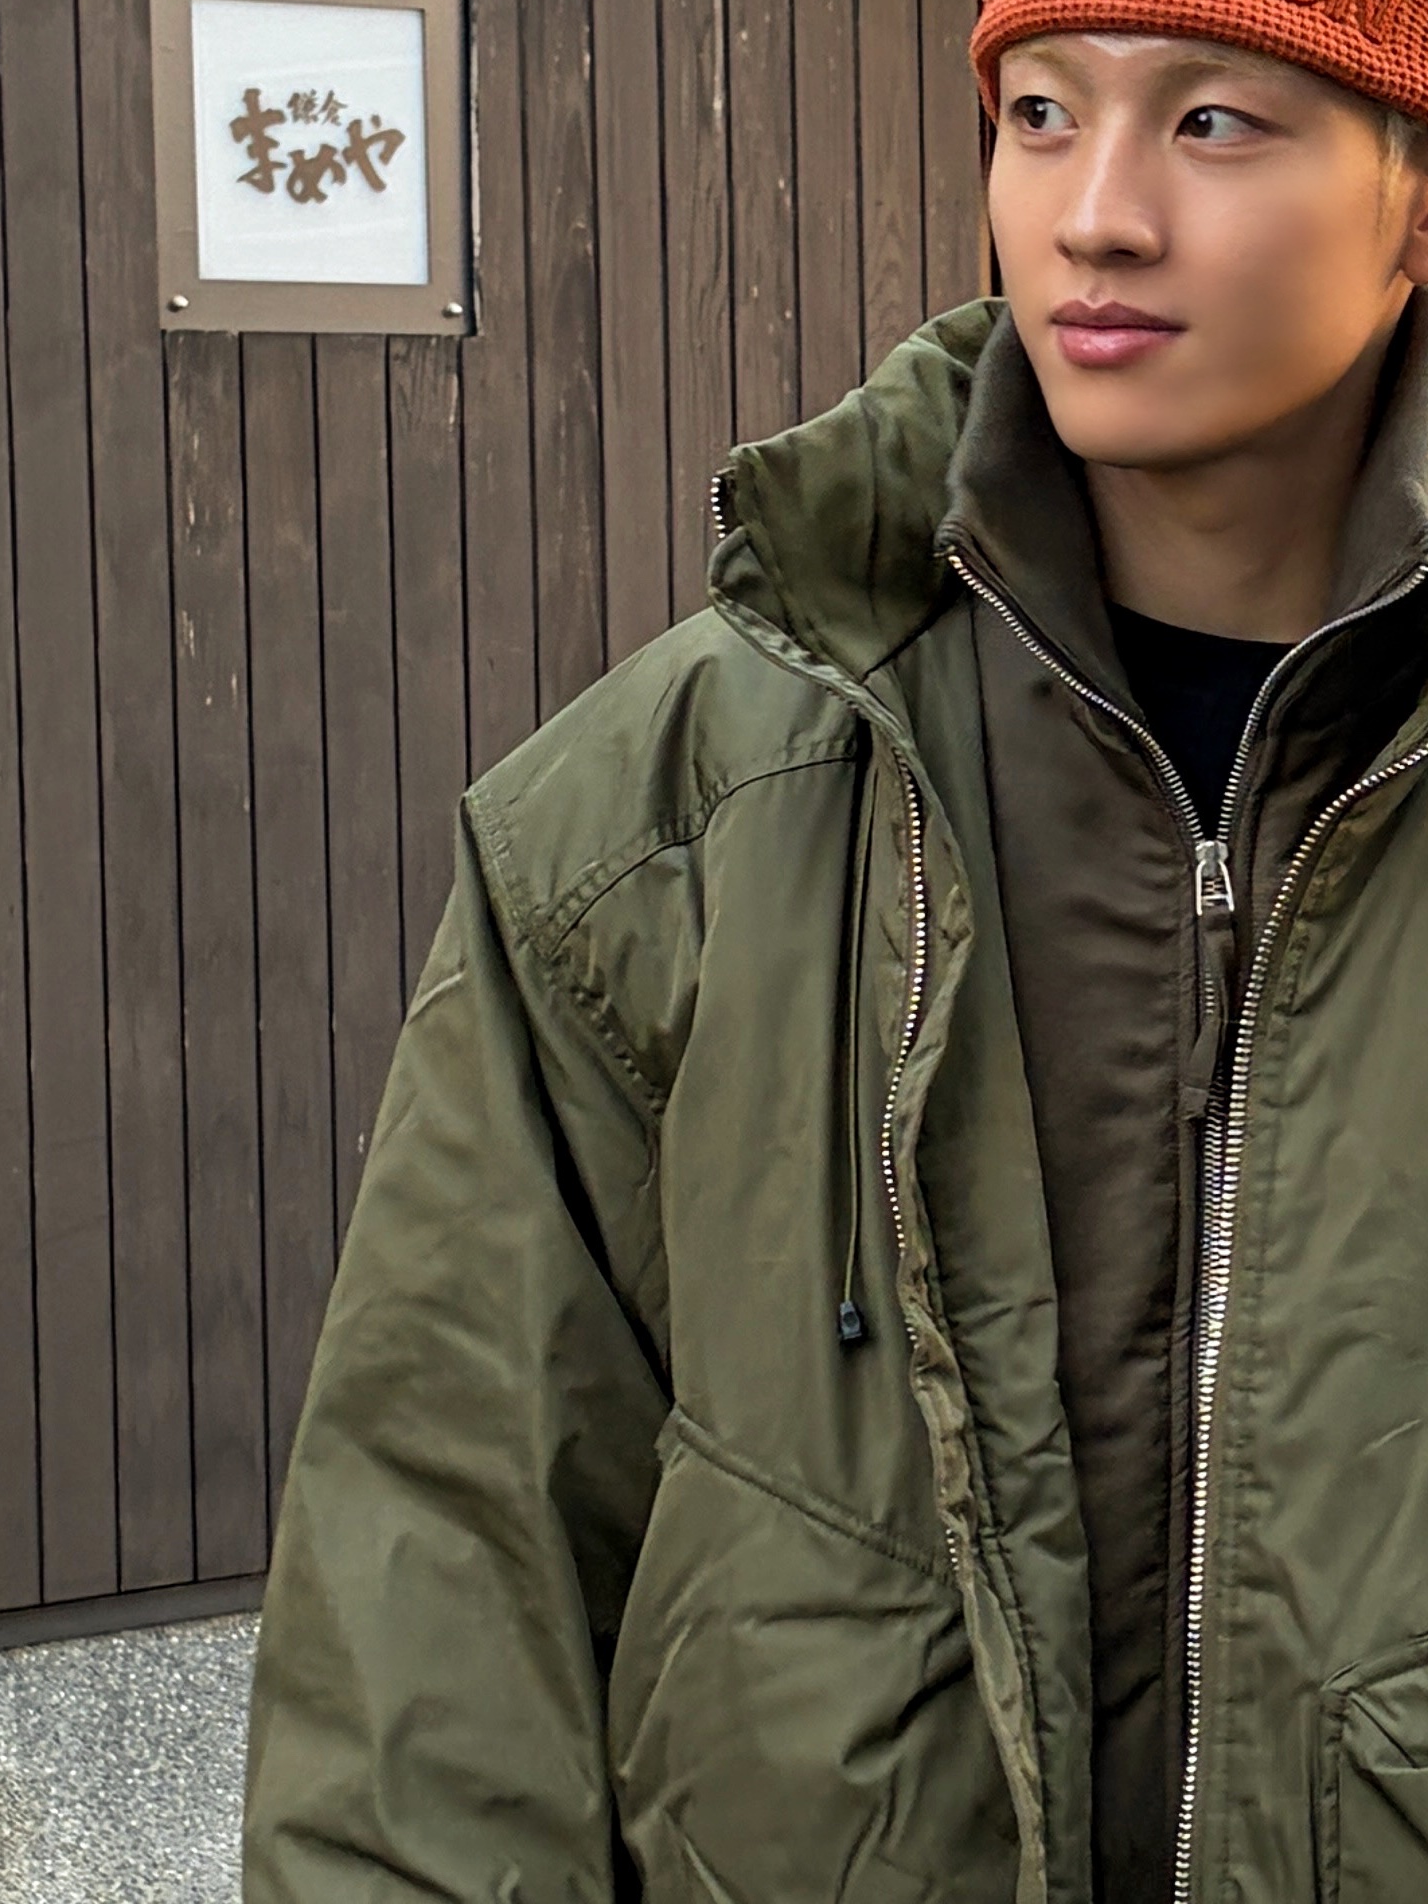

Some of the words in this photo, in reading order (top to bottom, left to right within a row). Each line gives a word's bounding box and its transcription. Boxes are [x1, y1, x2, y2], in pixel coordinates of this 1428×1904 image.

[228, 87, 406, 204] まめや
[286, 88, 349, 127] 鎌倉
